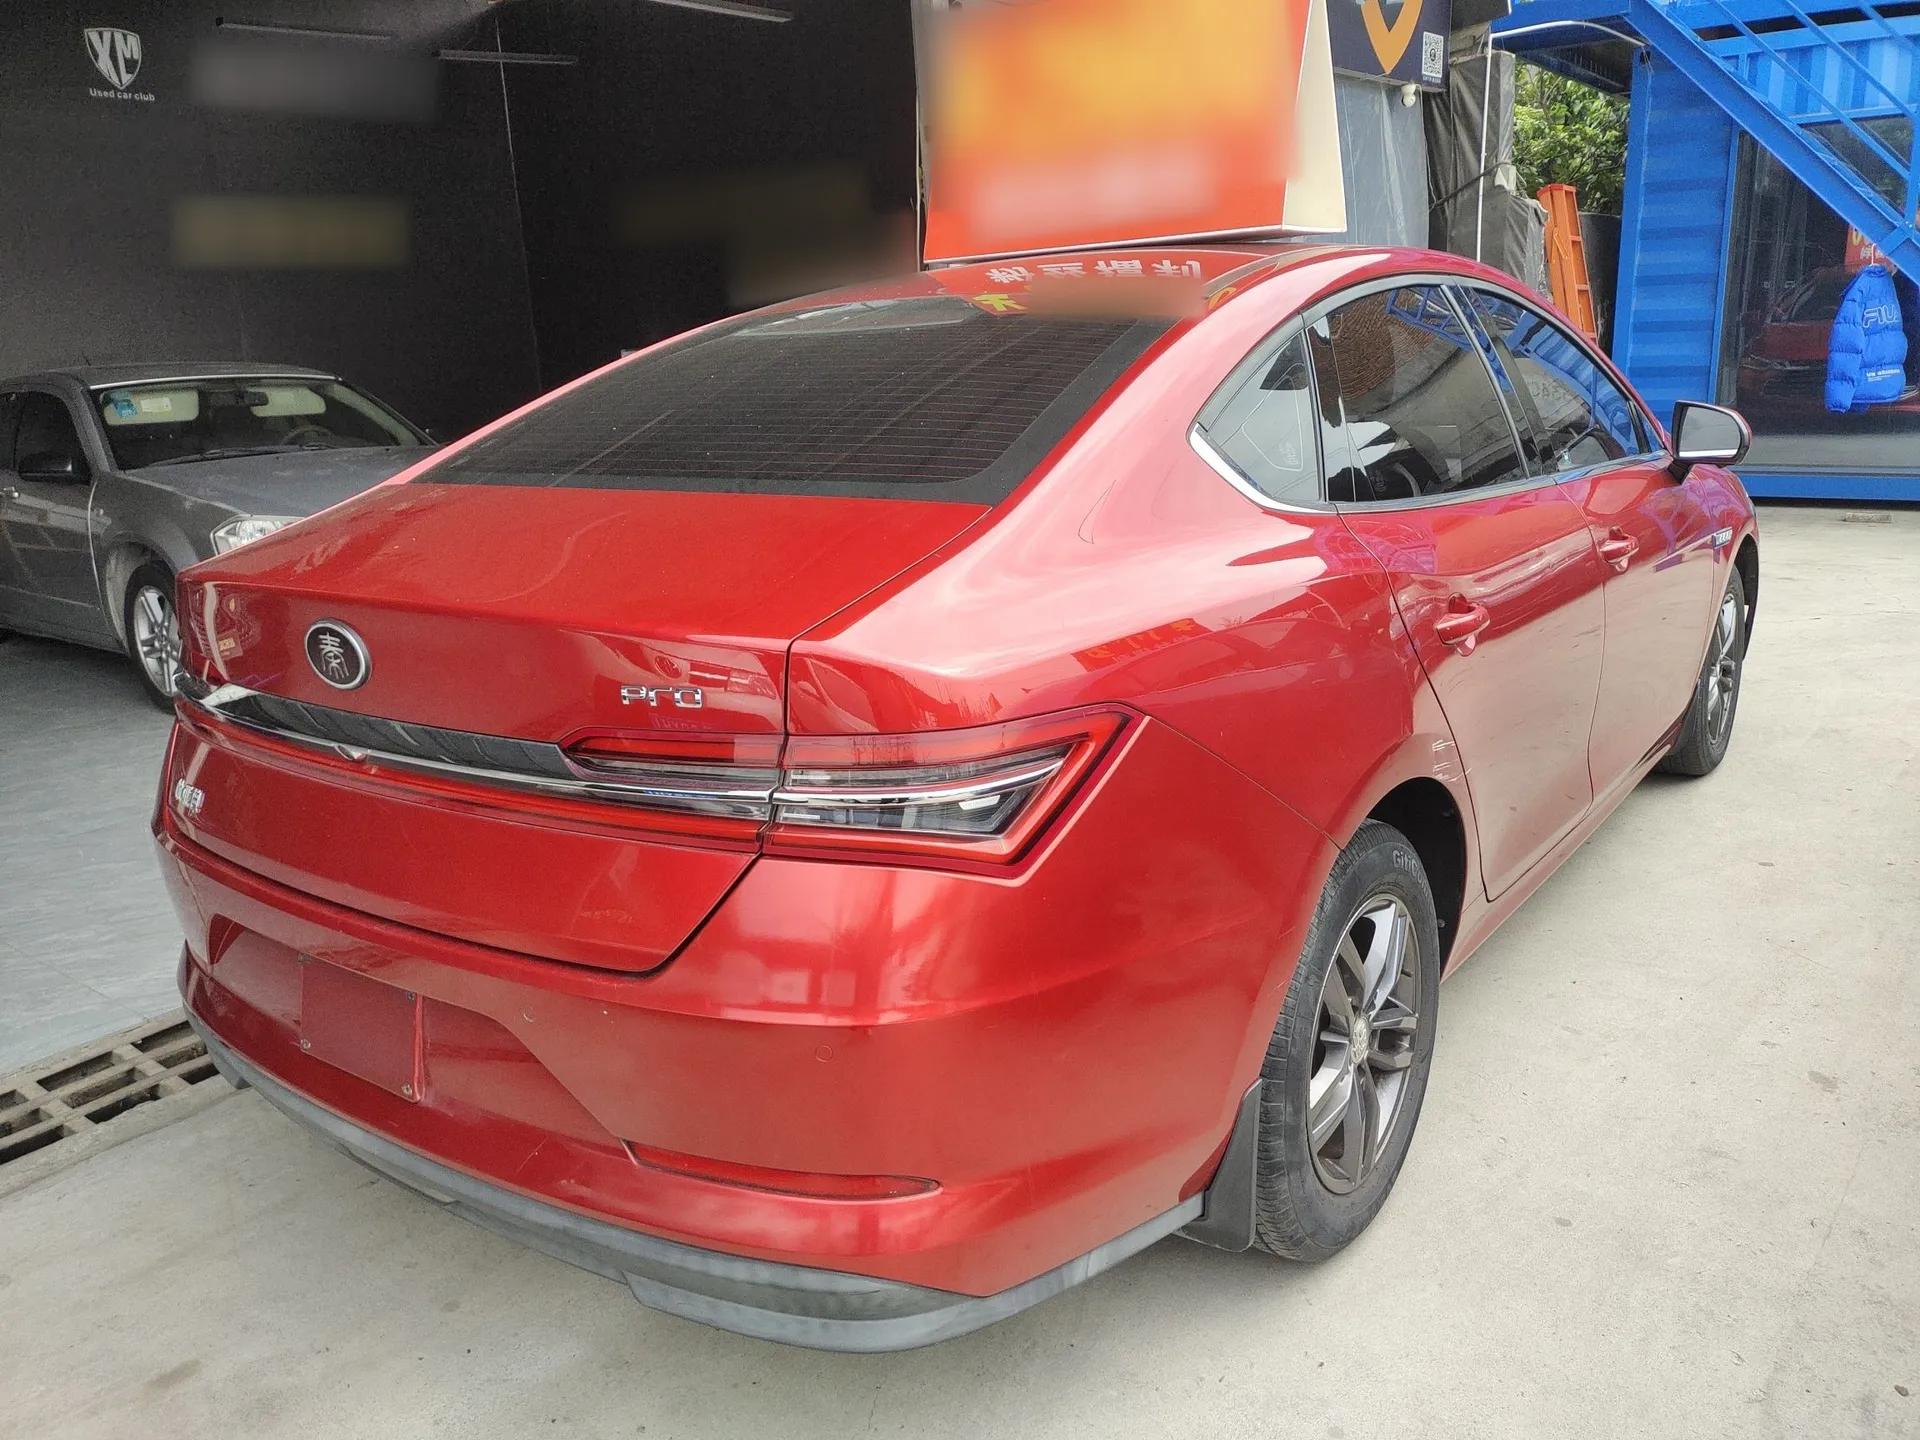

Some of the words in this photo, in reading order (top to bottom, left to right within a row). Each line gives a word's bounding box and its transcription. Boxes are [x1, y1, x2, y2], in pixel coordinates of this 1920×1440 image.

[89, 87, 115, 98] Used
[117, 90, 132, 100] car
[134, 91, 156, 102] club
